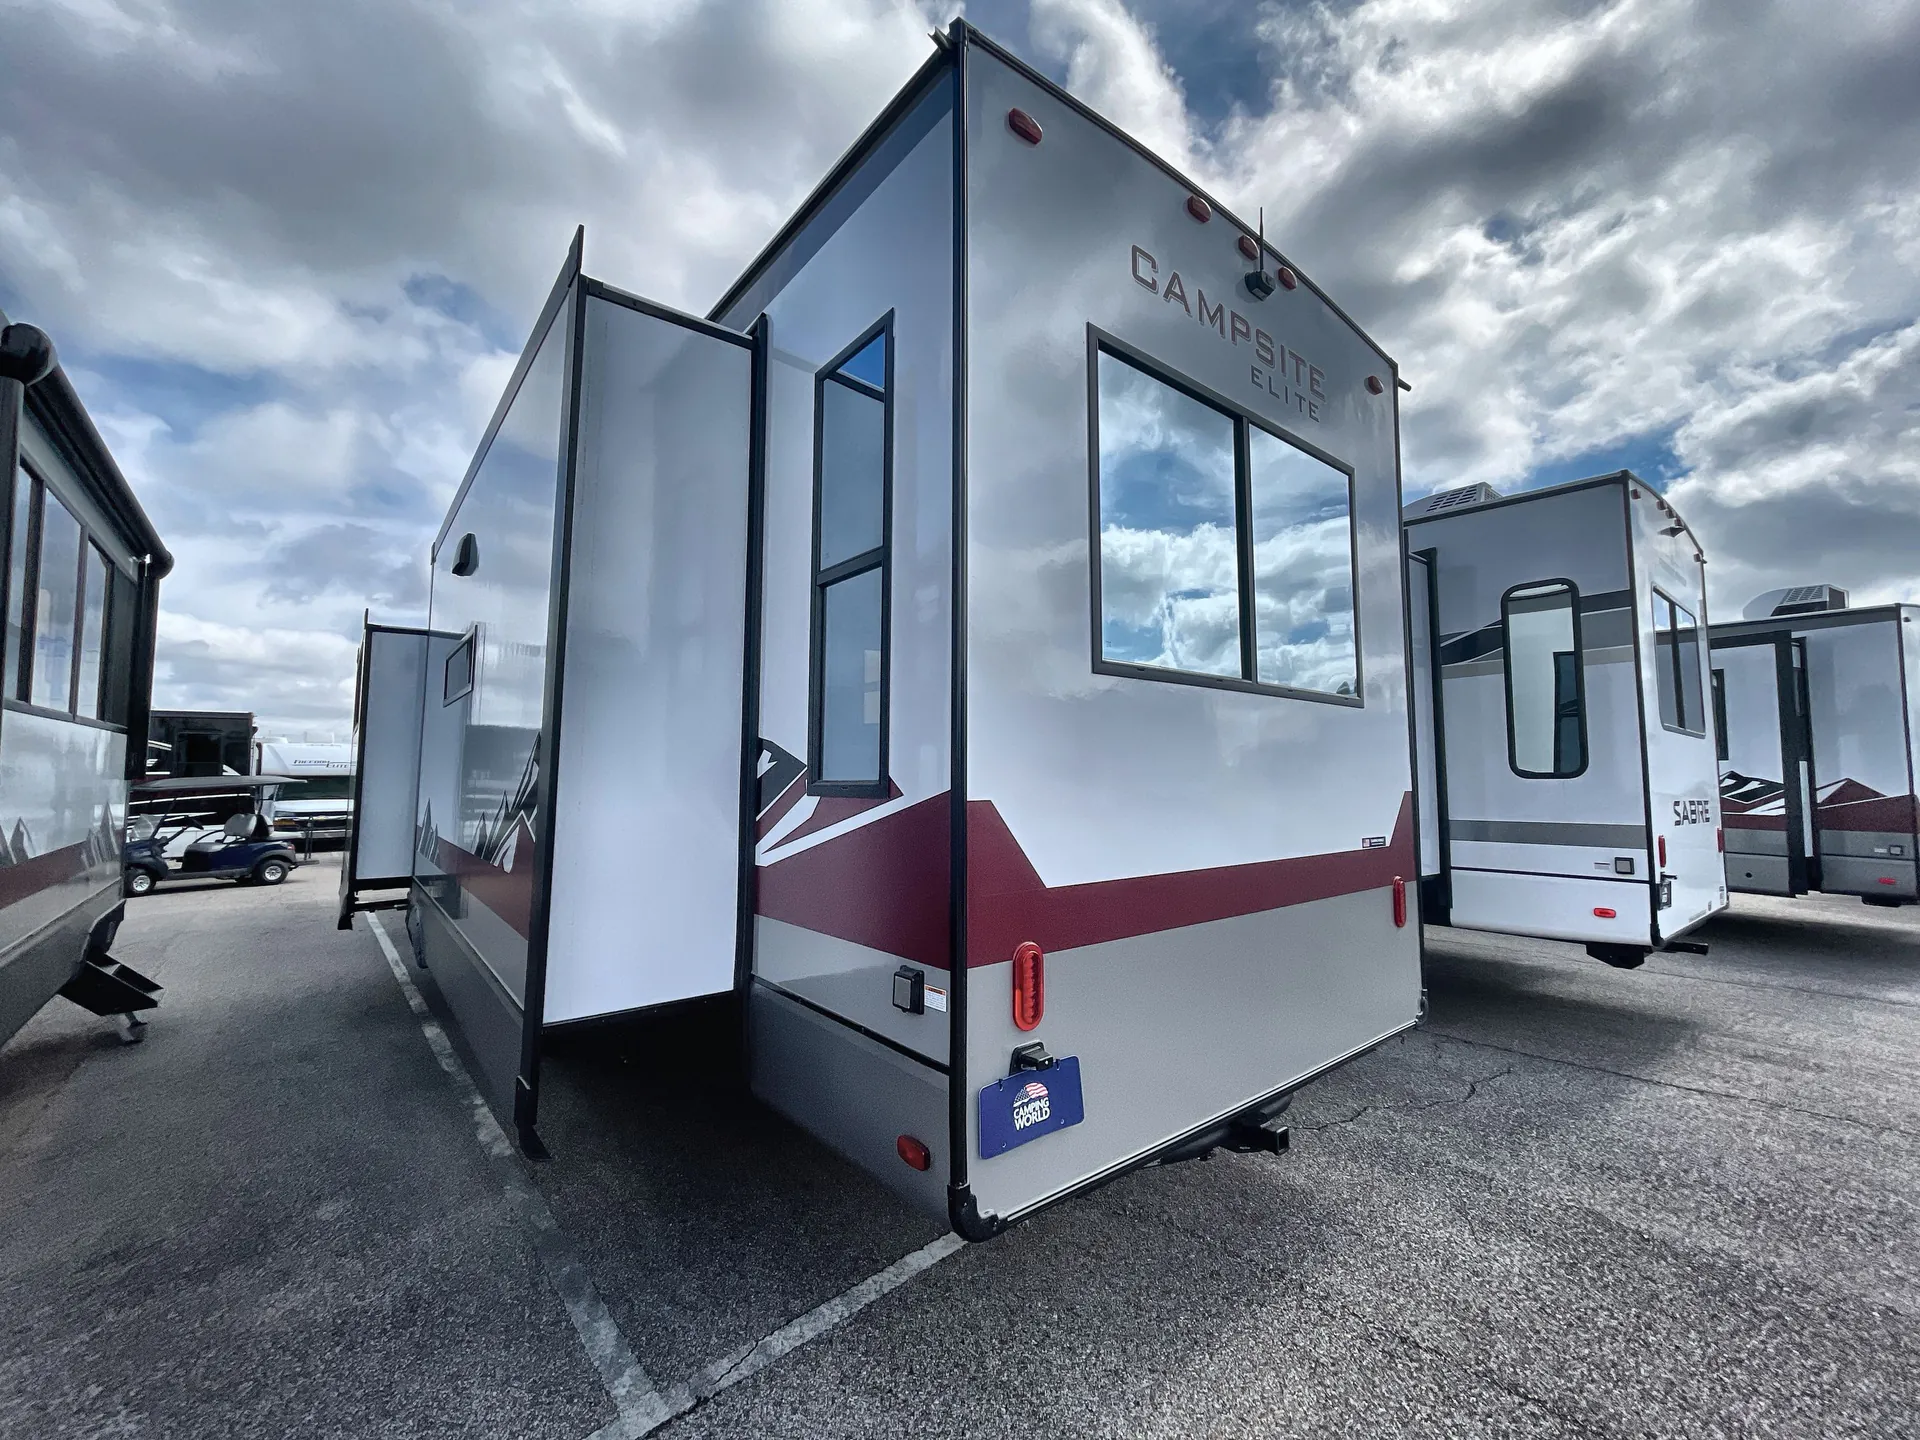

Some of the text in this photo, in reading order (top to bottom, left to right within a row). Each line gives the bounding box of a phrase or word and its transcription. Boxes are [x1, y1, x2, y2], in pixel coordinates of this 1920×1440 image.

[1131, 244, 1326, 402] CAMPSITE
[1251, 364, 1321, 423] ELITE
[1673, 800, 1710, 826] SABRE
[1013, 1097, 1050, 1119] CAMPING
[1014, 1107, 1051, 1131] WORLD
